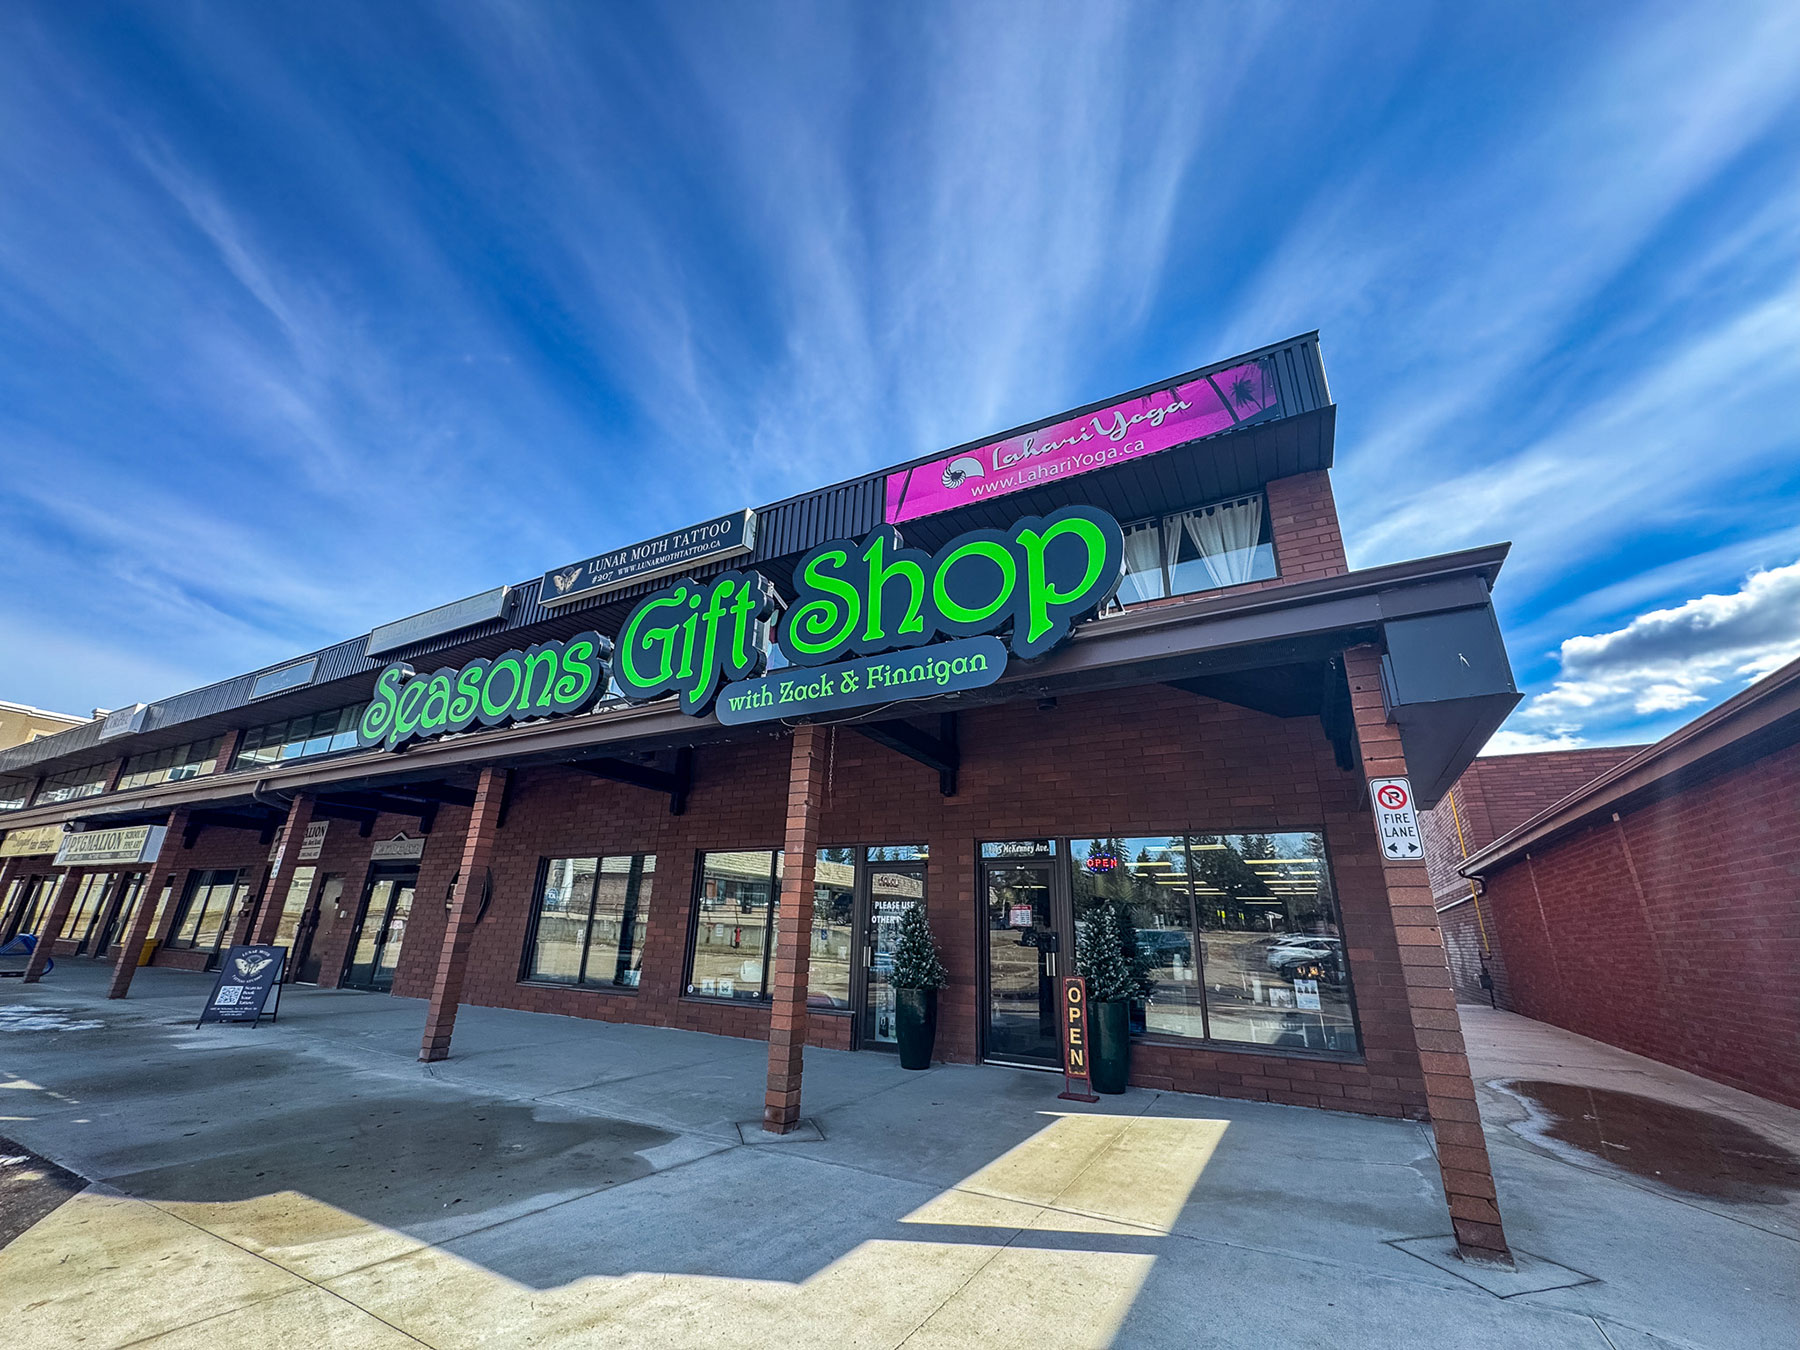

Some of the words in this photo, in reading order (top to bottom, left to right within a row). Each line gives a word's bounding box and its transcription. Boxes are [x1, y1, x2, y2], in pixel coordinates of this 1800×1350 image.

[992, 427, 1094, 471] Lahari
[1089, 397, 1193, 442] Yoga
[970, 438, 1145, 497] www.LahariYoga.ca
[588, 551, 627, 574] LUNAR
[630, 539, 668, 562] MOTH
[672, 519, 732, 549] TATTOO
[591, 570, 614, 584] #207
[617, 539, 721, 576] WWW.LUNARMOTHTATTOO.CA
[361, 641, 593, 744] Seasons
[621, 579, 757, 703] Gift
[788, 518, 1107, 655] Shop
[728, 683, 774, 712] with
[779, 672, 835, 704] Zack
[840, 669, 860, 694] &
[865, 653, 989, 690] Finnigan
[1383, 813, 1410, 824] FIRE
[1384, 826, 1416, 838] LANE
[67, 831, 125, 853] PYGMALION
[1035, 843, 1050, 852] Ave.
[1086, 858, 1118, 869] OPEN
[874, 901, 900, 910] PLEASE
[1067, 986, 1083, 1066] OPEN
